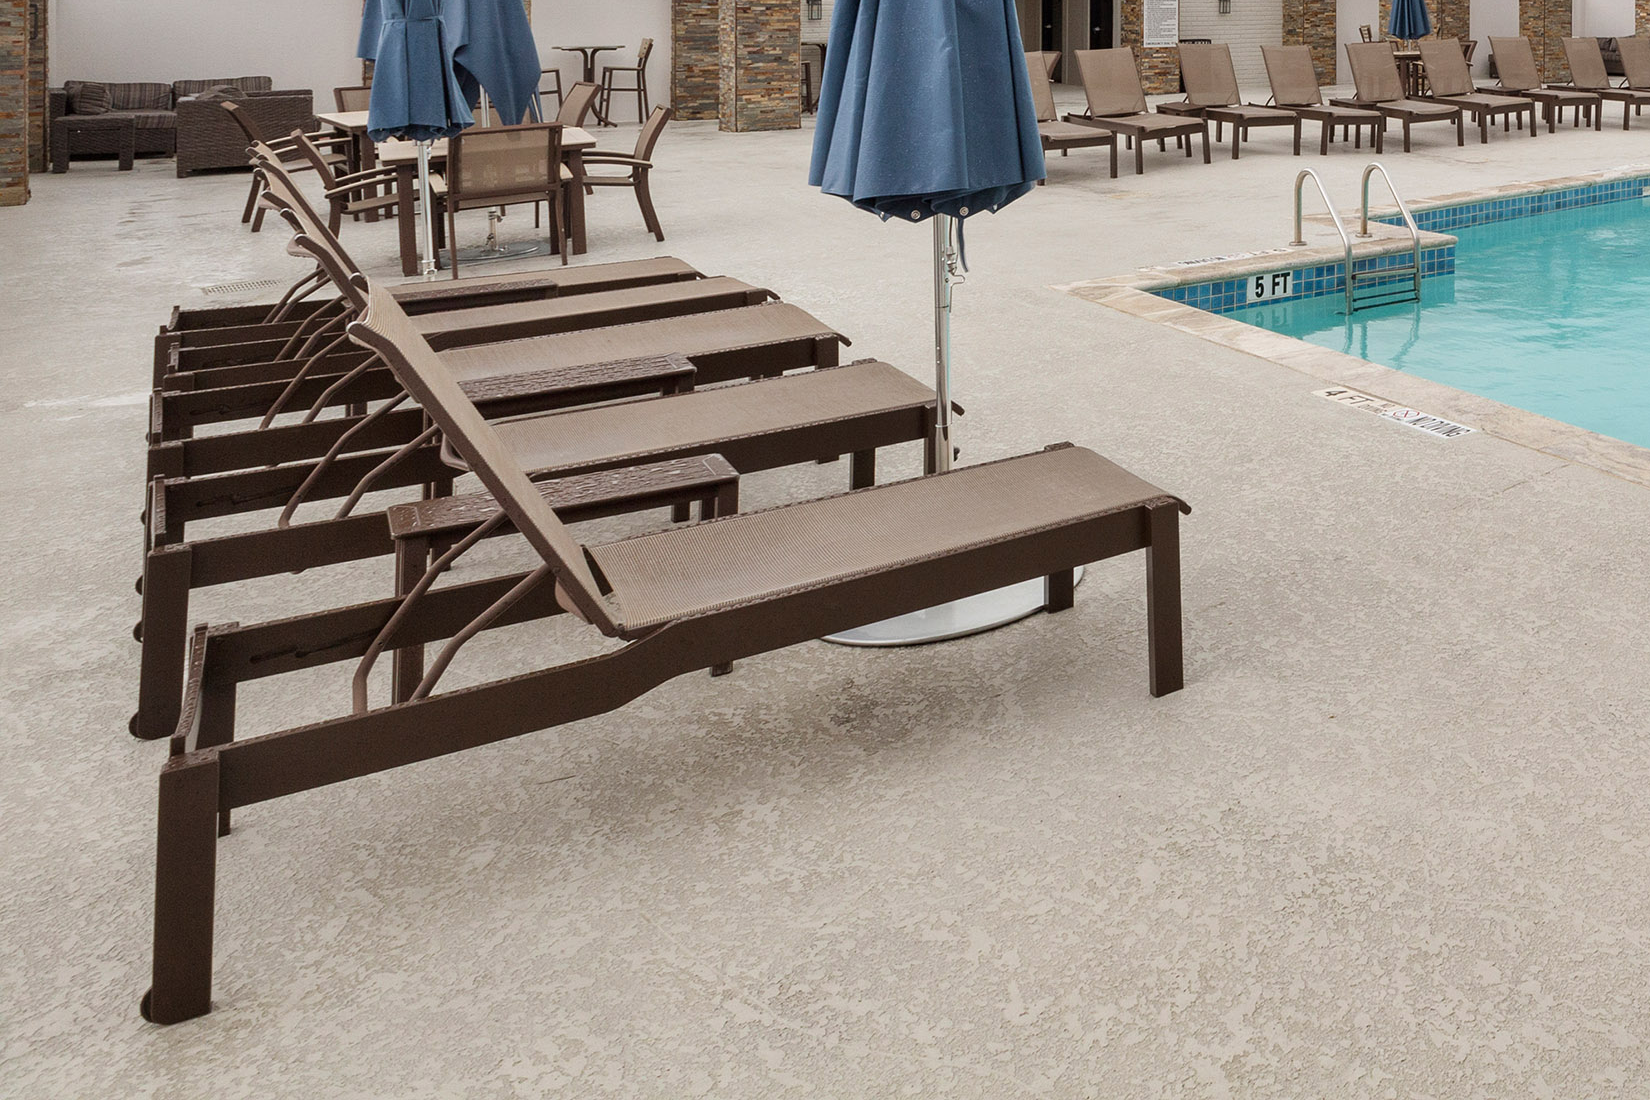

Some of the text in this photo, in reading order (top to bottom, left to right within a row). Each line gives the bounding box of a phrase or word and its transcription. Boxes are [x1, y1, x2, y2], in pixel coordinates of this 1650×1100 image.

[1255, 271, 1291, 298] 5 FT
[1338, 395, 1375, 404] FT
